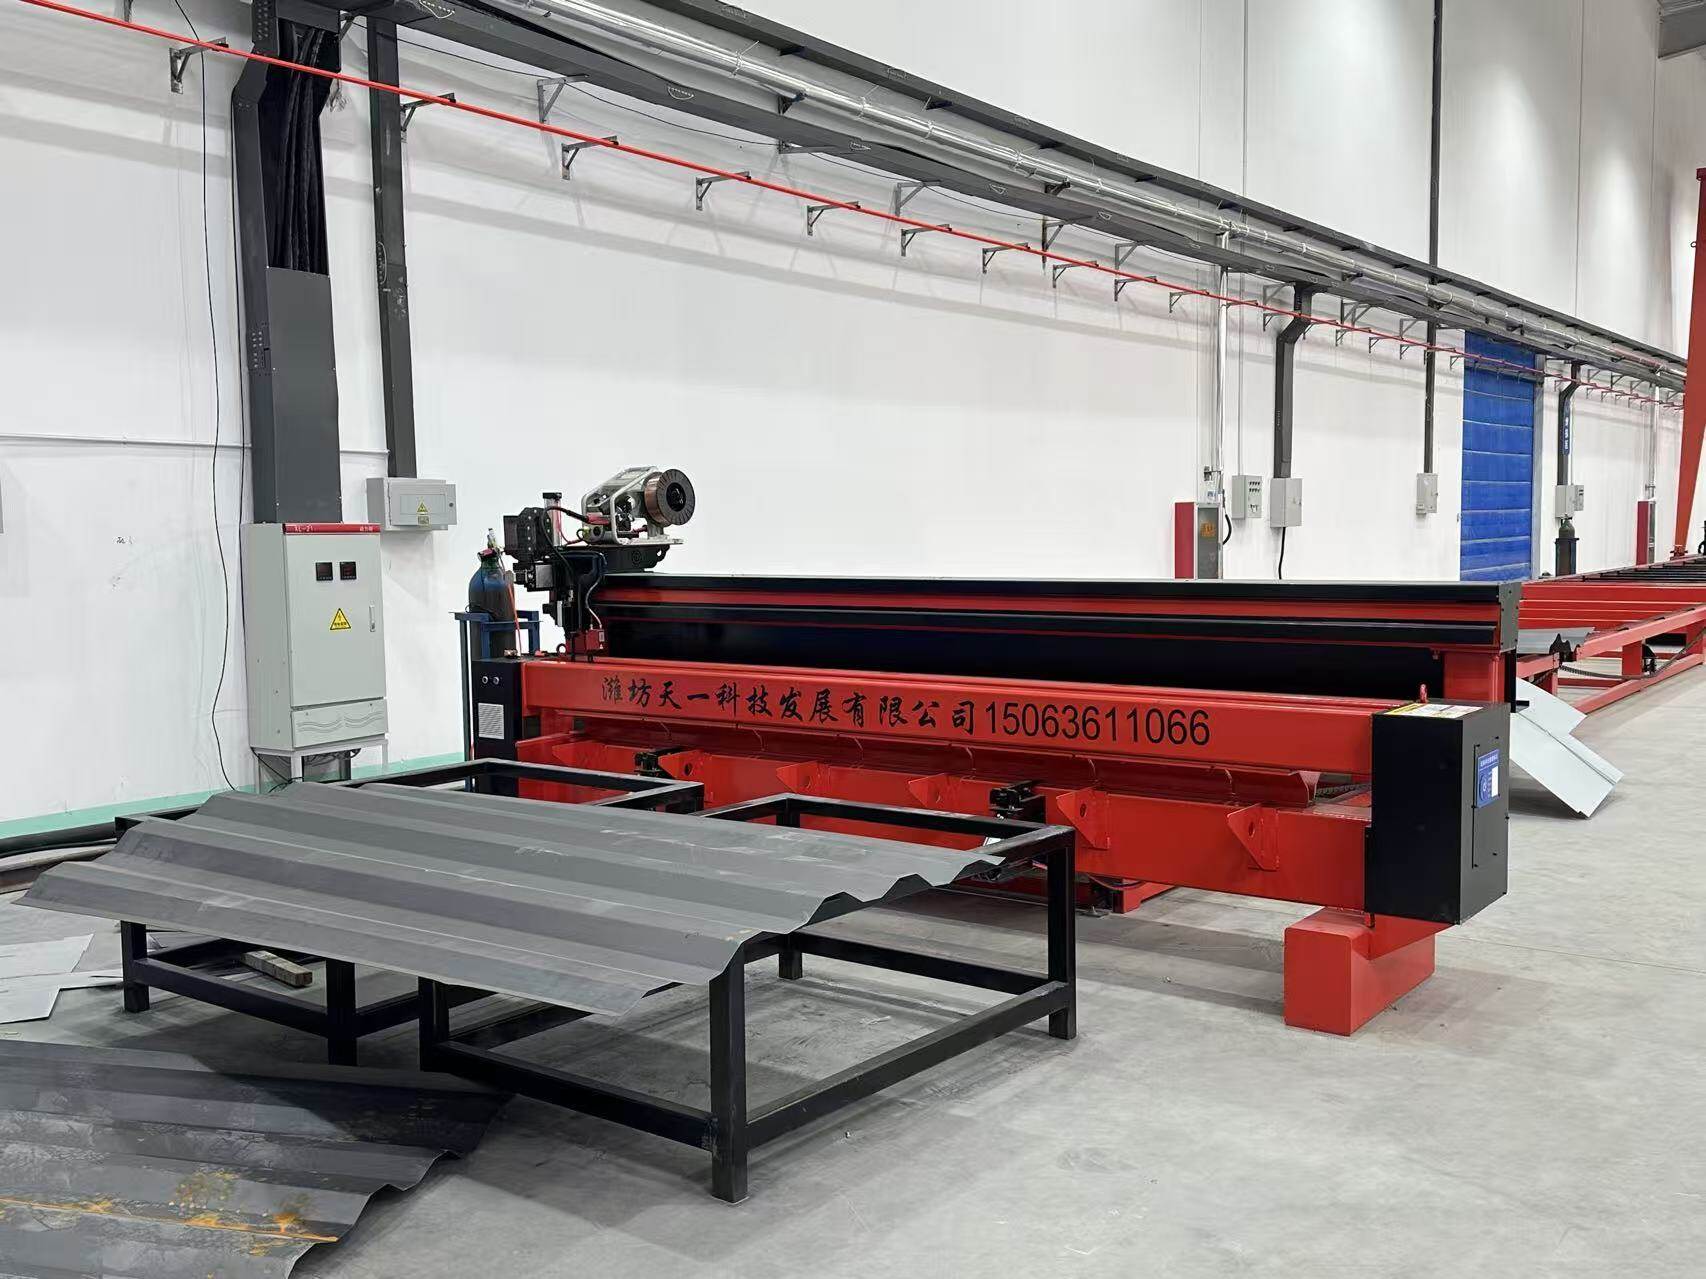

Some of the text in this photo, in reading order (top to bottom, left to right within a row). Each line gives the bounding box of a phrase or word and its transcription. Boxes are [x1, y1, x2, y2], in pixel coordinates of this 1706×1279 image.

[601, 676, 1210, 746] 潍坊天一科技发展有限公司 15063611066
